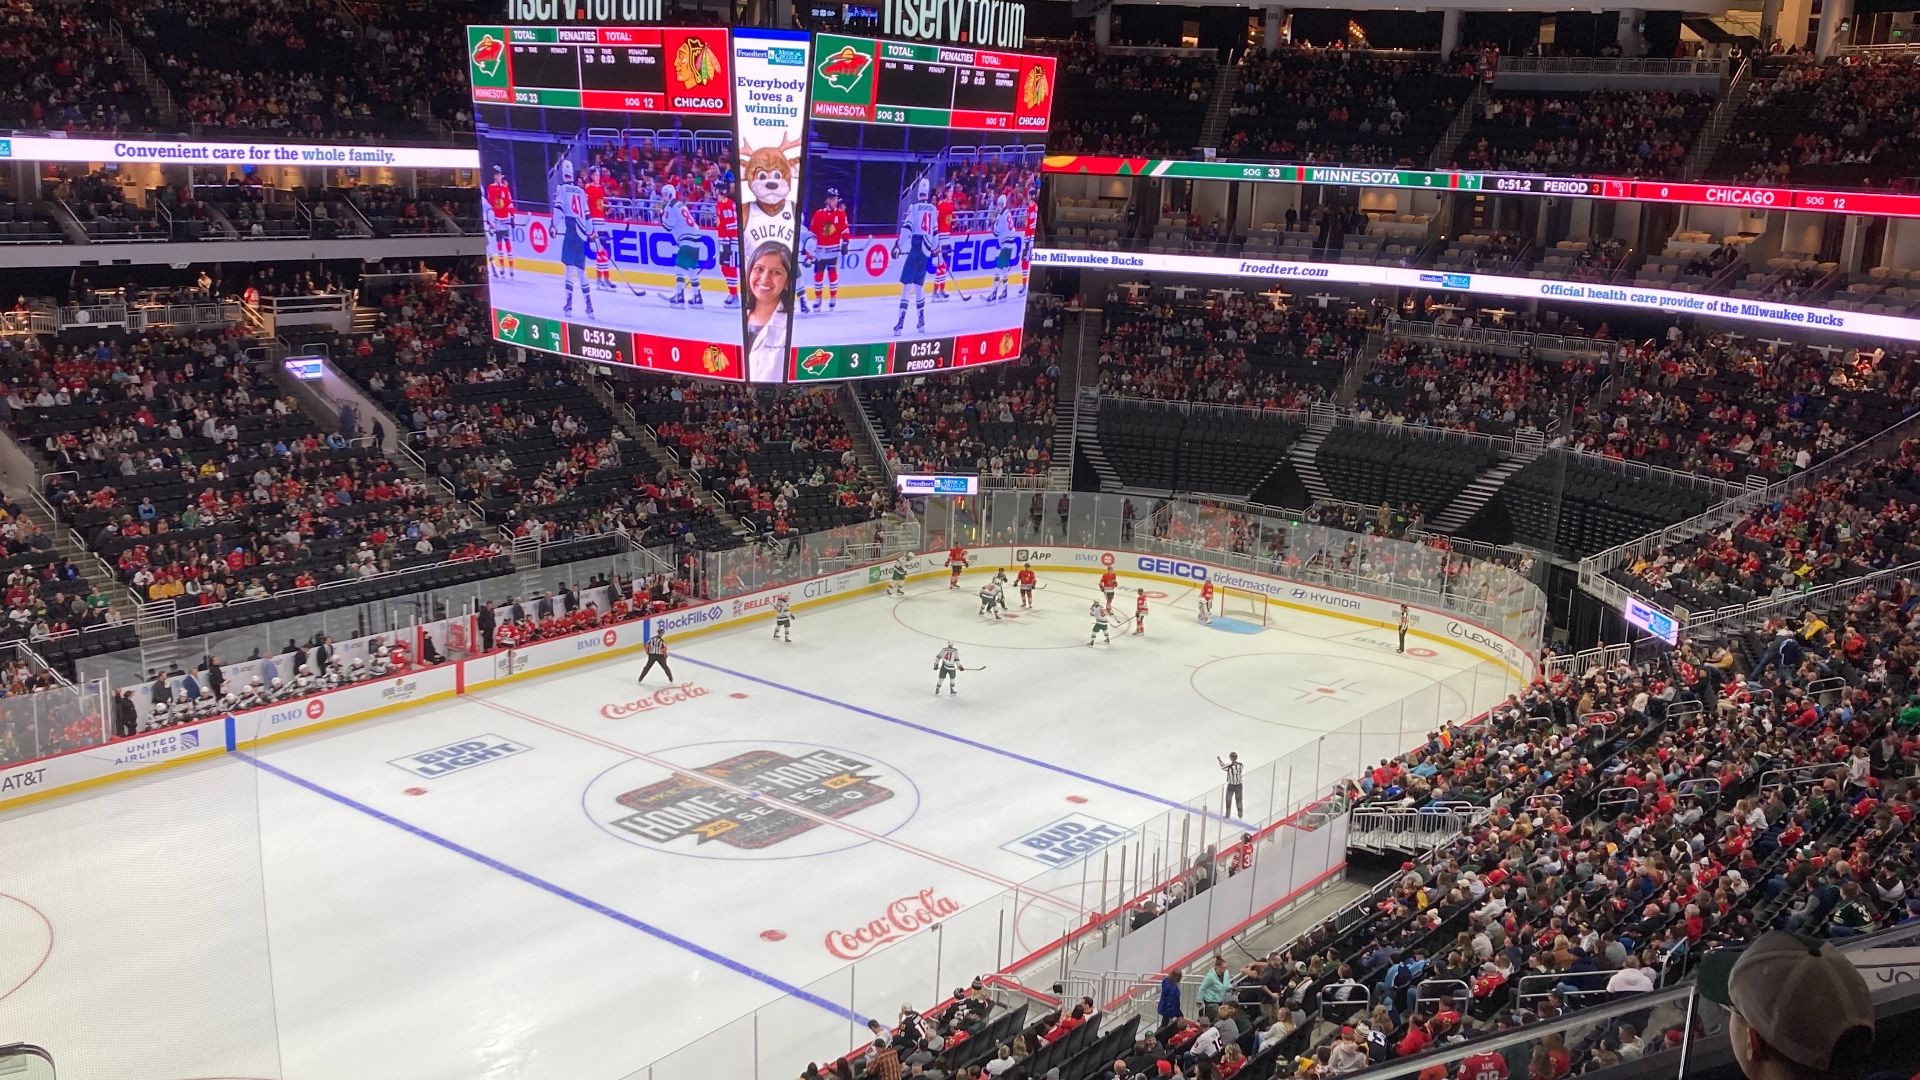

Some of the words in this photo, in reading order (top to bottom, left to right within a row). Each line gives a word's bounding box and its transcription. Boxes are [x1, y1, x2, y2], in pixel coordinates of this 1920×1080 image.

[513, 30, 536, 40] TOTAL:
[559, 31, 596, 41] PENALTIES
[605, 31, 632, 41] TOTAL:
[888, 45, 914, 57] TOTAL:
[940, 51, 974, 64] PENALTIES
[629, 56, 655, 65] TRIPPING
[981, 55, 1001, 65] TOTAL:
[737, 76, 805, 92] Everybody
[960, 76, 969, 84] 39
[475, 88, 508, 99] MINNESOTA
[515, 93, 528, 102] SOG
[529, 93, 538, 104] 33
[749, 90, 782, 102] loves
[785, 94, 793, 102] a
[624, 97, 640, 107] SOG
[643, 98, 654, 108] 12
[674, 97, 723, 109] CHICAGO
[744, 103, 798, 117] winning
[815, 104, 866, 118] MINNESOTA
[877, 111, 893, 120] SOG
[894, 111, 905, 122] 33
[752, 116, 789, 128] team.
[986, 117, 997, 125] SOG
[999, 117, 1006, 127] 12
[1018, 116, 1046, 125] CHICAGO
[114, 143, 209, 160] Convenient
[212, 145, 245, 160] care
[249, 144, 270, 160] for
[274, 144, 299, 161] the
[301, 146, 346, 162] whole
[348, 146, 396, 165] family.
[1242, 168, 1261, 178] SOG
[1267, 168, 1280, 179] 33
[1312, 169, 1401, 184] MINNESOTA
[1423, 175, 1431, 186] 3
[1497, 179, 1532, 191] 0:51.2
[1543, 180, 1588, 194] PERIOD
[1592, 183, 1600, 193] 3
[1618, 188, 1624, 197] 1
[1661, 187, 1668, 198] 0
[1705, 188, 1775, 205] CHICAGO
[571, 195, 582, 215] 41
[1805, 196, 1824, 206] SOG
[1833, 198, 1846, 209] 12
[921, 211, 932, 235] 41
[750, 224, 794, 242] BUCKS
[1030, 252, 1047, 263] the
[1050, 252, 1109, 266] Milwaukee
[1111, 254, 1144, 267] Bucks
[1239, 261, 1329, 278] froedtert.com
[1540, 284, 1585, 299] Official
[1588, 287, 1627, 302] health
[1630, 292, 1657, 304] care
[1659, 295, 1705, 312] provider
[1706, 300, 1718, 312] of
[1720, 301, 1739, 314] the
[1741, 304, 1804, 322] Milwaukee
[1806, 311, 1844, 327] Bucks
[532, 325, 539, 340] 3
[583, 328, 616, 347] 0:51.2
[555, 341, 560, 352] 1
[911, 342, 940, 357] 0:51.2
[980, 341, 986, 354] 0
[582, 346, 612, 360] PERIOD
[615, 351, 622, 362] 3
[671, 347, 680, 362] 0
[850, 353, 859, 368] 3
[962, 355, 967, 366] 1
[648, 356, 653, 367] 1
[876, 363, 882, 374] 1
[906, 358, 935, 371] PERIOD
[937, 358, 943, 368] 3
[1075, 553, 1098, 562] BMO
[1137, 557, 1207, 580] GEICO
[803, 579, 832, 598] GTL
[1213, 571, 1282, 595] ticketmaster
[744, 597, 769, 610] BELLE
[1310, 592, 1361, 610] HYUNDAI
[656, 611, 707, 631] BlockFills
[577, 637, 600, 650] BMO
[1464, 629, 1504, 653] LEXUS
[600, 682, 709, 719] Coca-Cola
[271, 708, 303, 725] BMO
[127, 736, 176, 754] UNITED
[115, 745, 177, 765] AIRLINES
[414, 740, 488, 766] BUD
[417, 743, 519, 777] LIGHT
[756, 753, 862, 789] HOME
[1, 768, 47, 791] AT&T
[736, 787, 826, 821] SEIES
[620, 796, 736, 840] HOME
[1021, 821, 1087, 850] BUD
[1035, 824, 1123, 867] LIGHT
[824, 886, 960, 961] Coca-Cola
